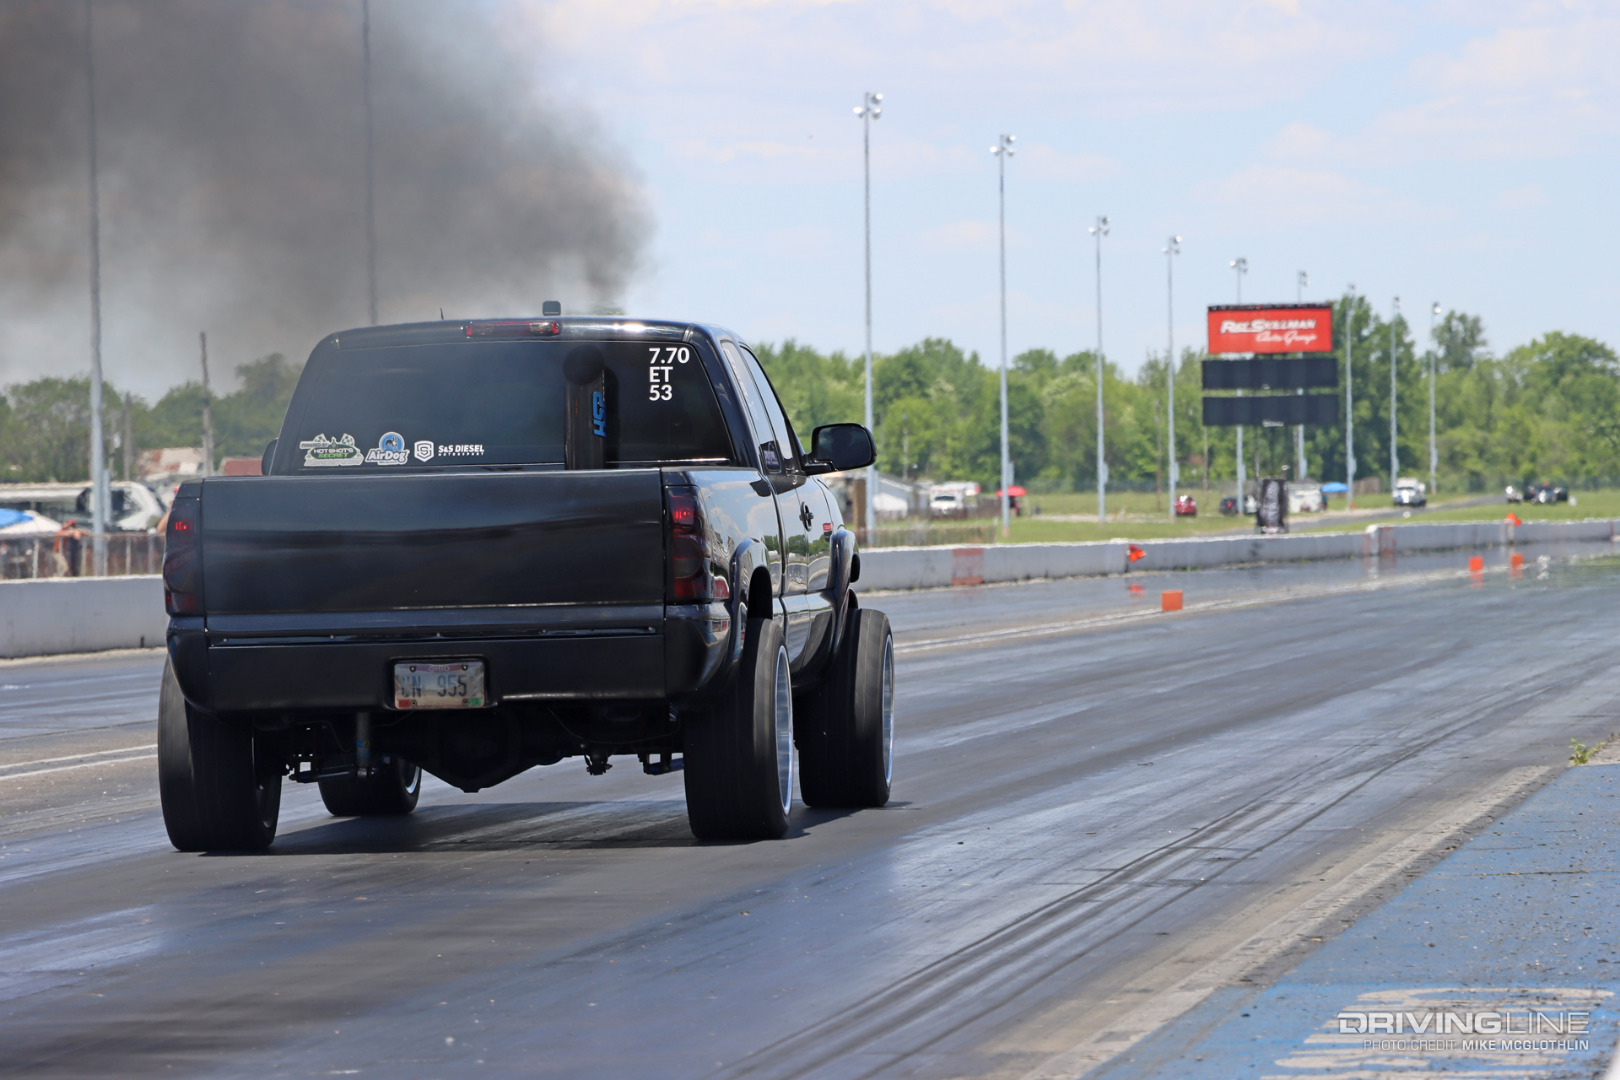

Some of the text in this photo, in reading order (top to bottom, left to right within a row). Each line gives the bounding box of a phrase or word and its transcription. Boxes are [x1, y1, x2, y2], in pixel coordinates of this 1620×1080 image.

[648, 347, 690, 364] 7.70
[649, 366, 673, 383] ET
[648, 384, 673, 401] 53
[369, 450, 406, 462] AirDog
[438, 444, 485, 453] S&S DIESEL
